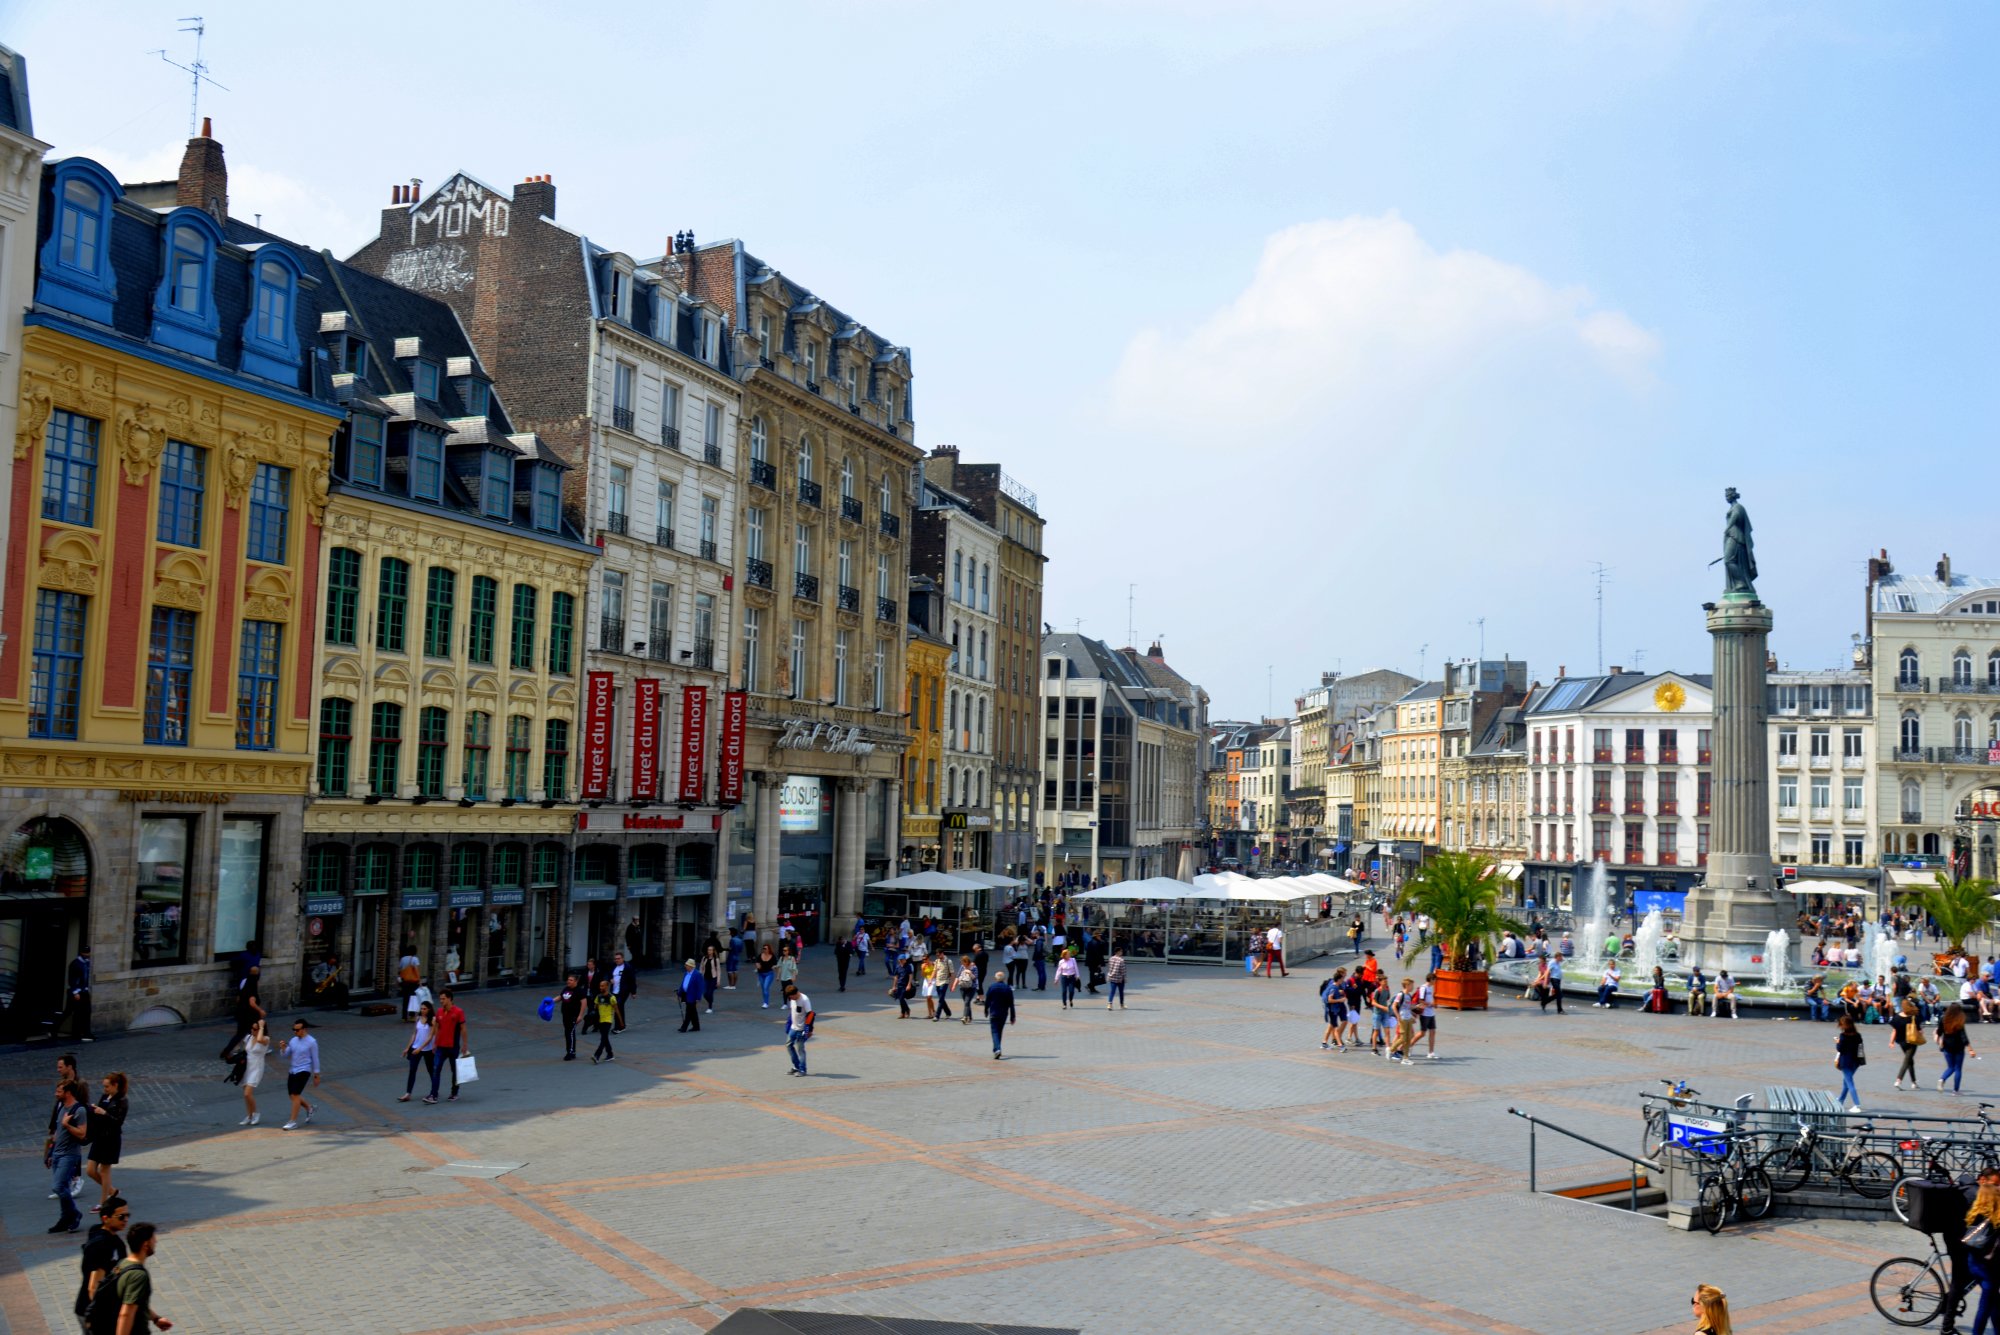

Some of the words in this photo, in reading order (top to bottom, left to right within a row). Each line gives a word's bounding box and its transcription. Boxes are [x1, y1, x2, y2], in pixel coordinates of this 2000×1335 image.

[436, 177, 481, 204] SAN
[410, 199, 510, 246] MOMO
[594, 677, 609, 718] nord
[641, 683, 654, 722] nord
[689, 690, 702, 728] nord
[730, 697, 742, 732] nord
[592, 721, 605, 745] du
[639, 726, 653, 748] du
[688, 731, 700, 753] du
[727, 735, 740, 756] du
[588, 747, 605, 793] Furet
[637, 750, 652, 795] Furet
[685, 755, 699, 797] Furet
[724, 759, 739, 799] Furet
[118, 790, 156, 803] BNP
[160, 791, 231, 804] PARIBAS
[308, 902, 343, 912] voyages
[408, 898, 433, 906] presse
[1672, 1126, 1684, 1141] P
